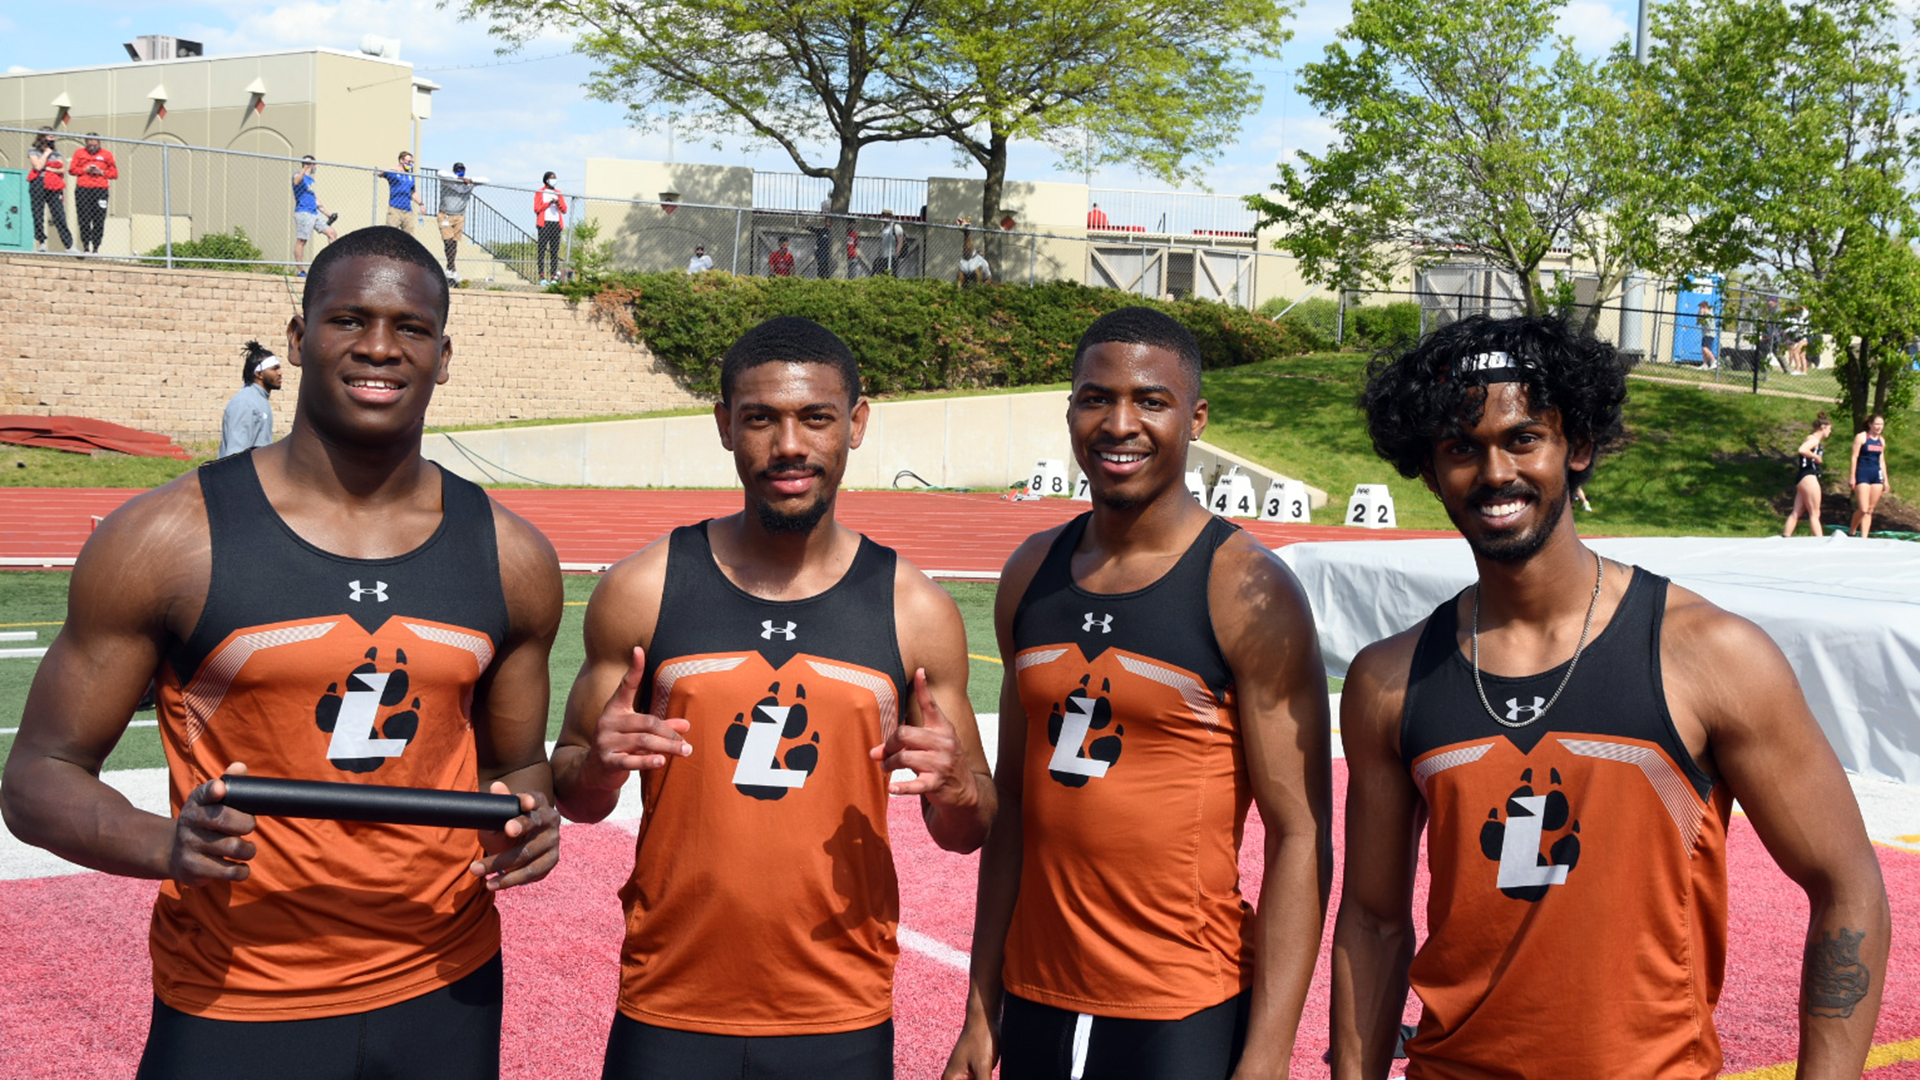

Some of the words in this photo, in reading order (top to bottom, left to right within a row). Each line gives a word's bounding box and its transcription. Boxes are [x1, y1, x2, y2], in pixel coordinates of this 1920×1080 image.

[1032, 475, 1042, 491] 8
[1052, 476, 1062, 492] 8
[1080, 480, 1088, 496] 7
[1215, 493, 1227, 512] 4
[1238, 495, 1249, 513] 4
[1267, 498, 1280, 517] 3
[1291, 500, 1302, 518] 3
[1352, 503, 1366, 523] 2
[1377, 504, 1388, 523] 2
[326, 672, 408, 759] L
[732, 705, 808, 788] L
[1048, 696, 1110, 778] L
[1496, 795, 1569, 888] L
